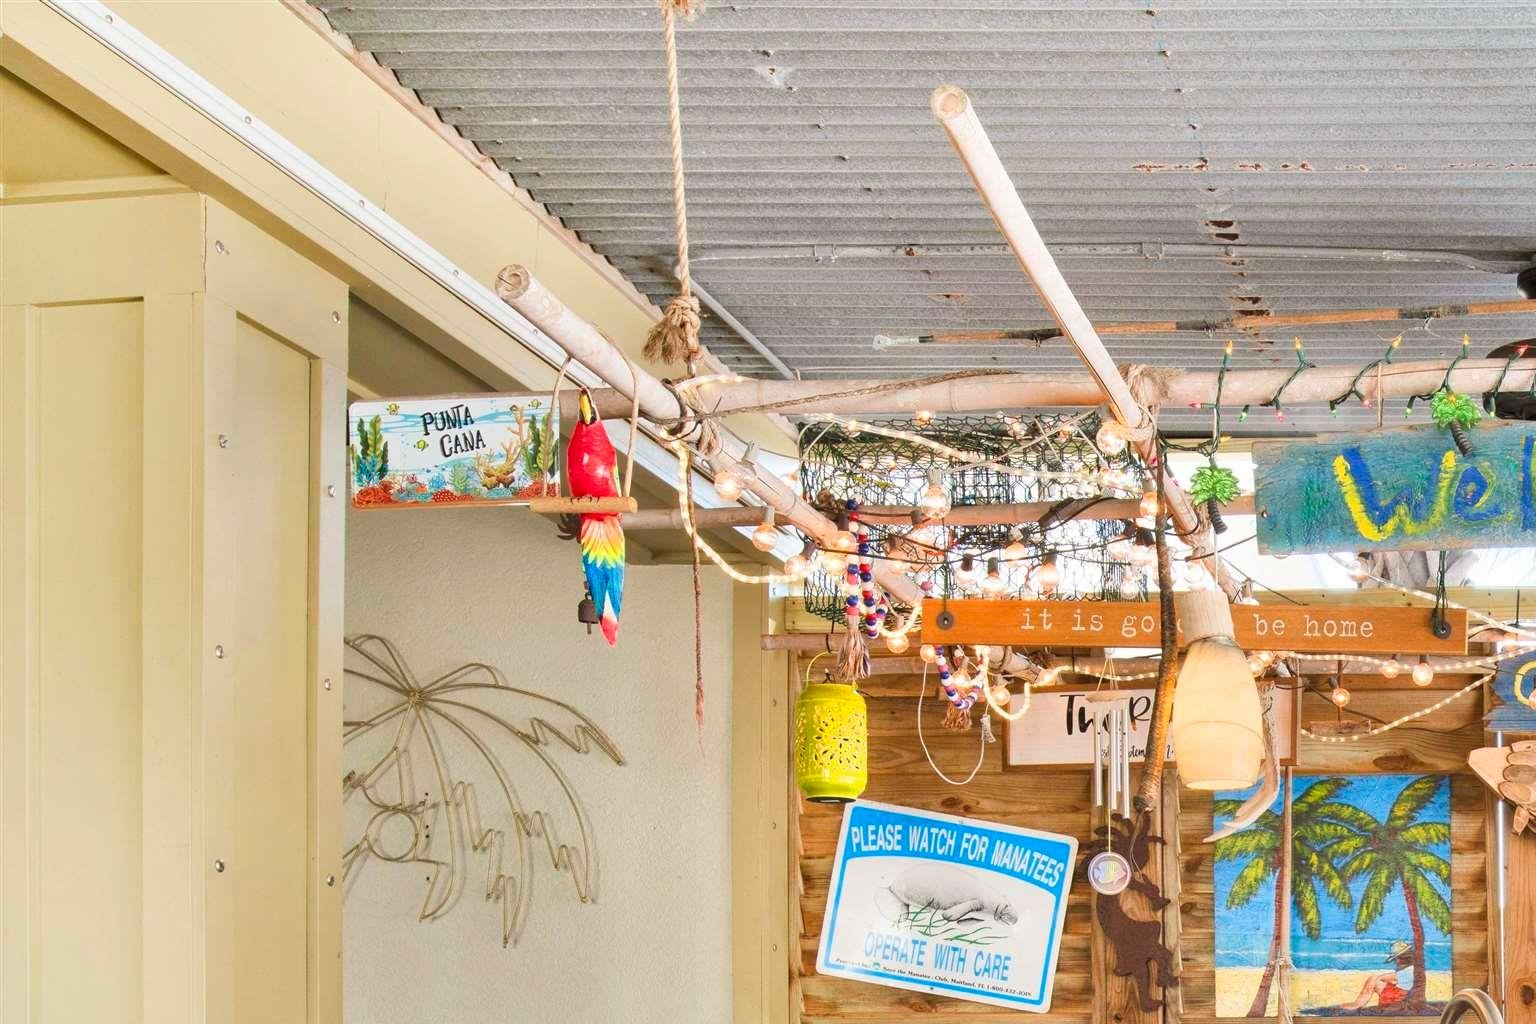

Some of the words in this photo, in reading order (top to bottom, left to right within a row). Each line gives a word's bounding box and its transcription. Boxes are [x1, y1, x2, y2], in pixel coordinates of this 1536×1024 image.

[420, 404, 474, 435] PUNTA
[440, 430, 486, 457] CANA
[1021, 608, 1052, 631] it
[1072, 609, 1103, 631] is
[1254, 613, 1286, 638] be
[1304, 615, 1375, 639] home
[851, 825, 902, 852] PLEASE
[909, 826, 955, 855] WATCH
[960, 832, 989, 862] FOR
[991, 839, 1065, 887] MANATEES
[864, 932, 927, 966] OPERATE
[934, 943, 966, 973] WITH
[973, 950, 1012, 981] CARE
